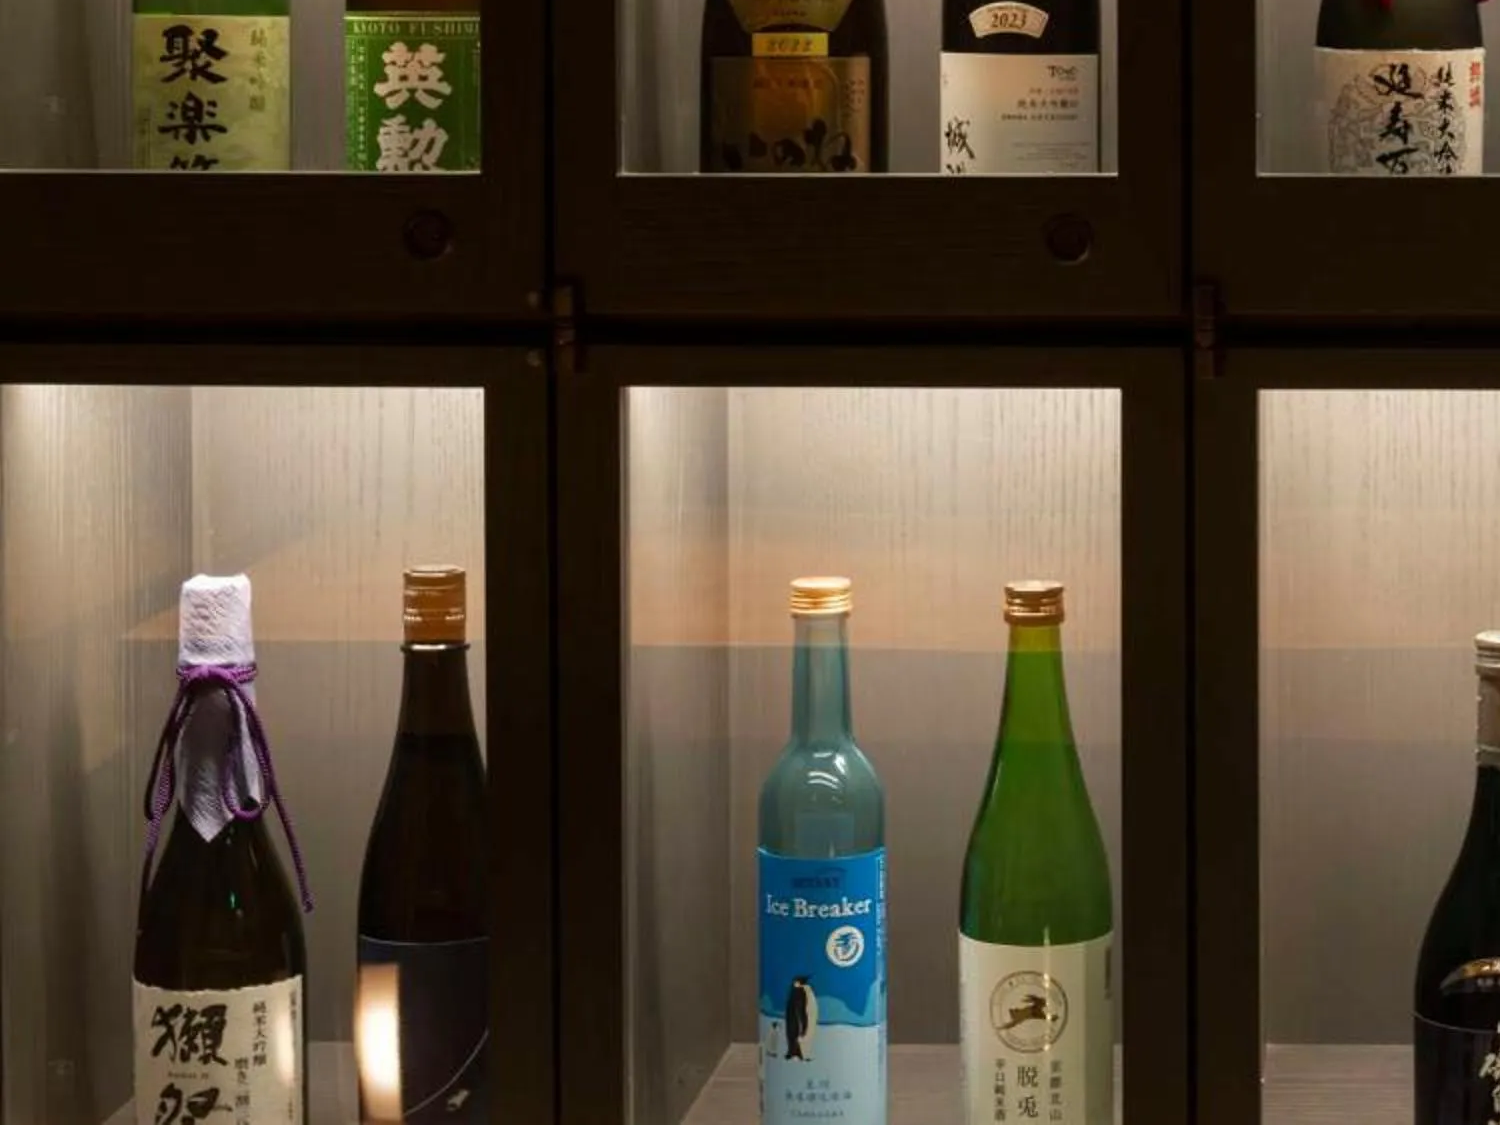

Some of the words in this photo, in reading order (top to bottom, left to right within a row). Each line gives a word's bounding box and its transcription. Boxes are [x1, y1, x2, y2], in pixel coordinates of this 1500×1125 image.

[990, 13, 1027, 28] 2023
[765, 893, 790, 917] Ice
[793, 895, 873, 919] Breaker
